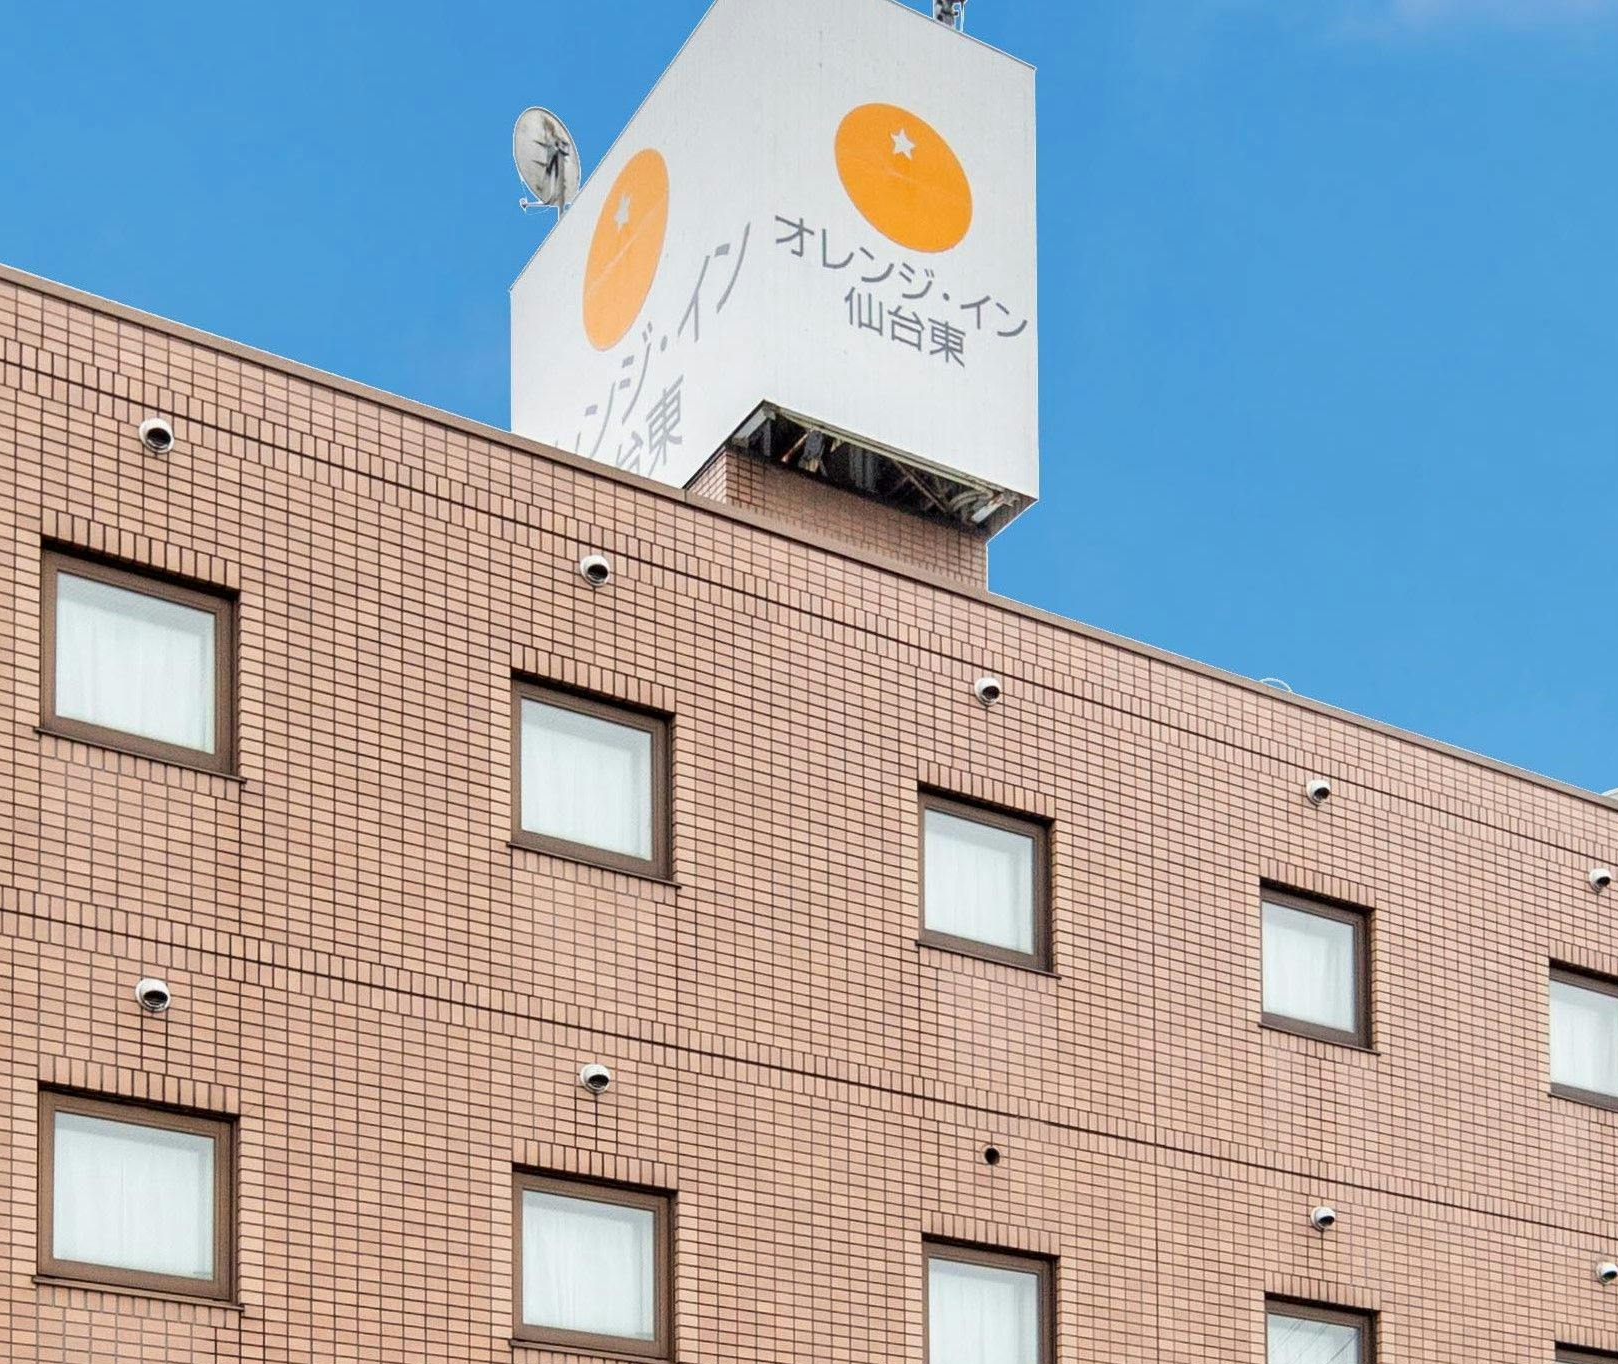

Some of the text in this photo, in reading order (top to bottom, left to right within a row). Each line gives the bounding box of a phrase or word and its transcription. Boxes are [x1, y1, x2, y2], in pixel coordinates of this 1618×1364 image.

[774, 214, 1028, 338] オレンジ・イン
[844, 286, 967, 368] 仙台東
